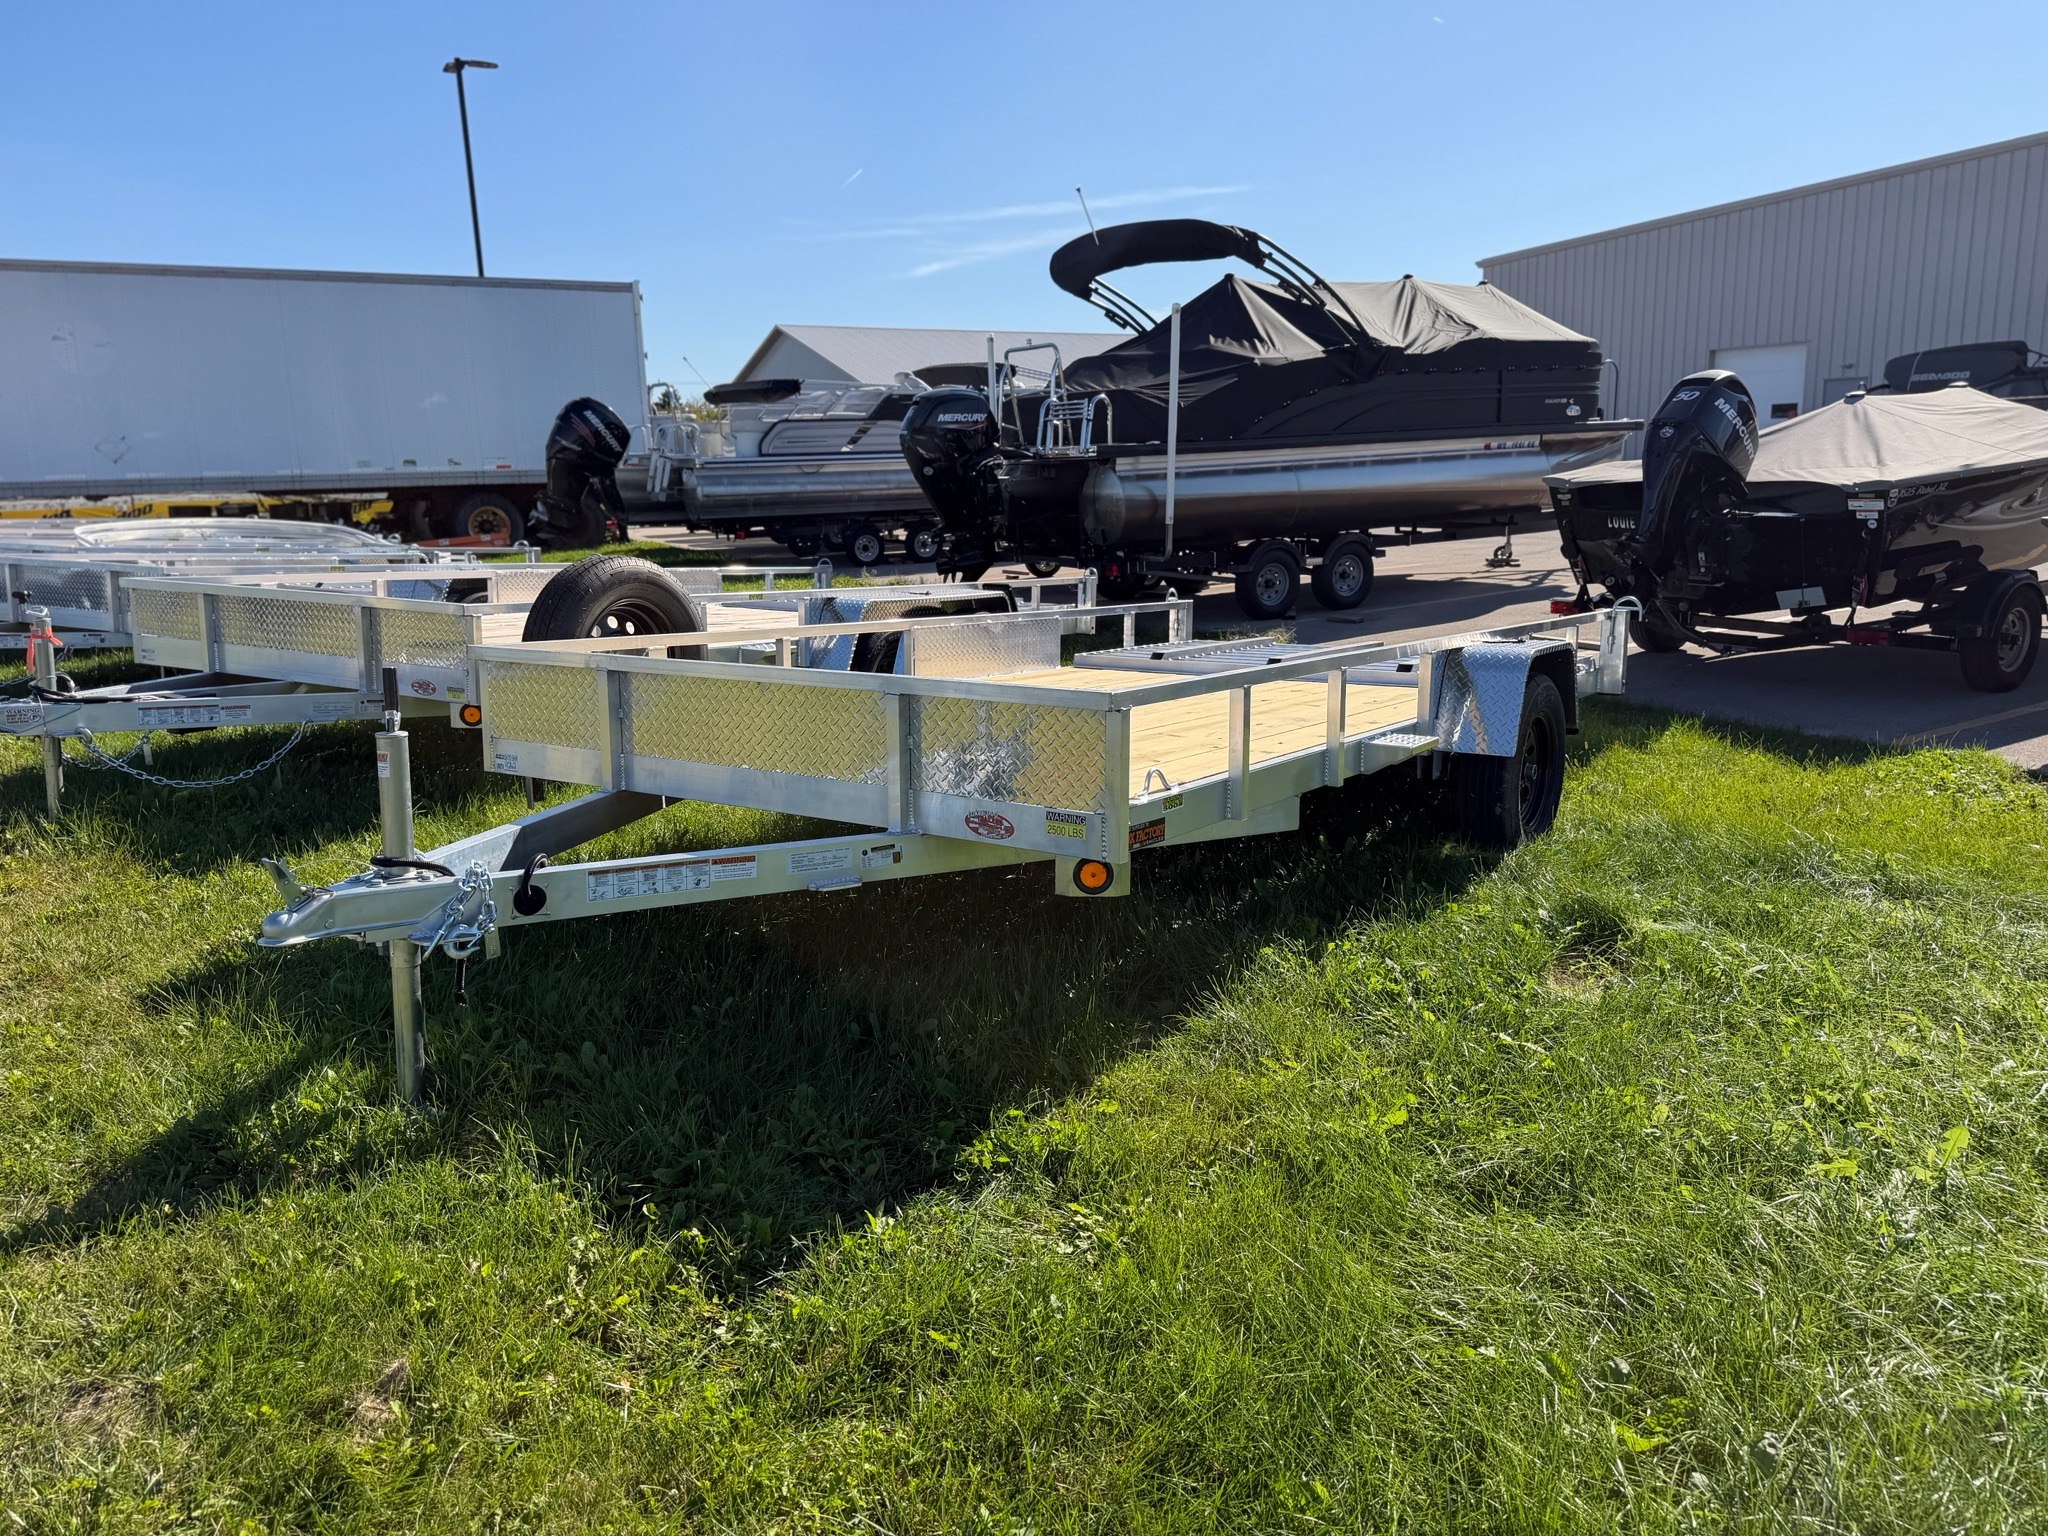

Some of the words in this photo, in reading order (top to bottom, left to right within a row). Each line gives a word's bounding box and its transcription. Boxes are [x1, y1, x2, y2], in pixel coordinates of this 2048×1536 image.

[1671, 391, 1701, 402] 50
[937, 413, 988, 422] MERCURY
[582, 409, 624, 452] MERCURY
[1713, 397, 1755, 460] MERCURY
[1607, 515, 1637, 530] LOUIE
[1047, 811, 1086, 826] WARNING
[1047, 824, 1067, 837] 2500
[1067, 826, 1085, 840] LBS
[1136, 824, 1165, 844] FACTORY
